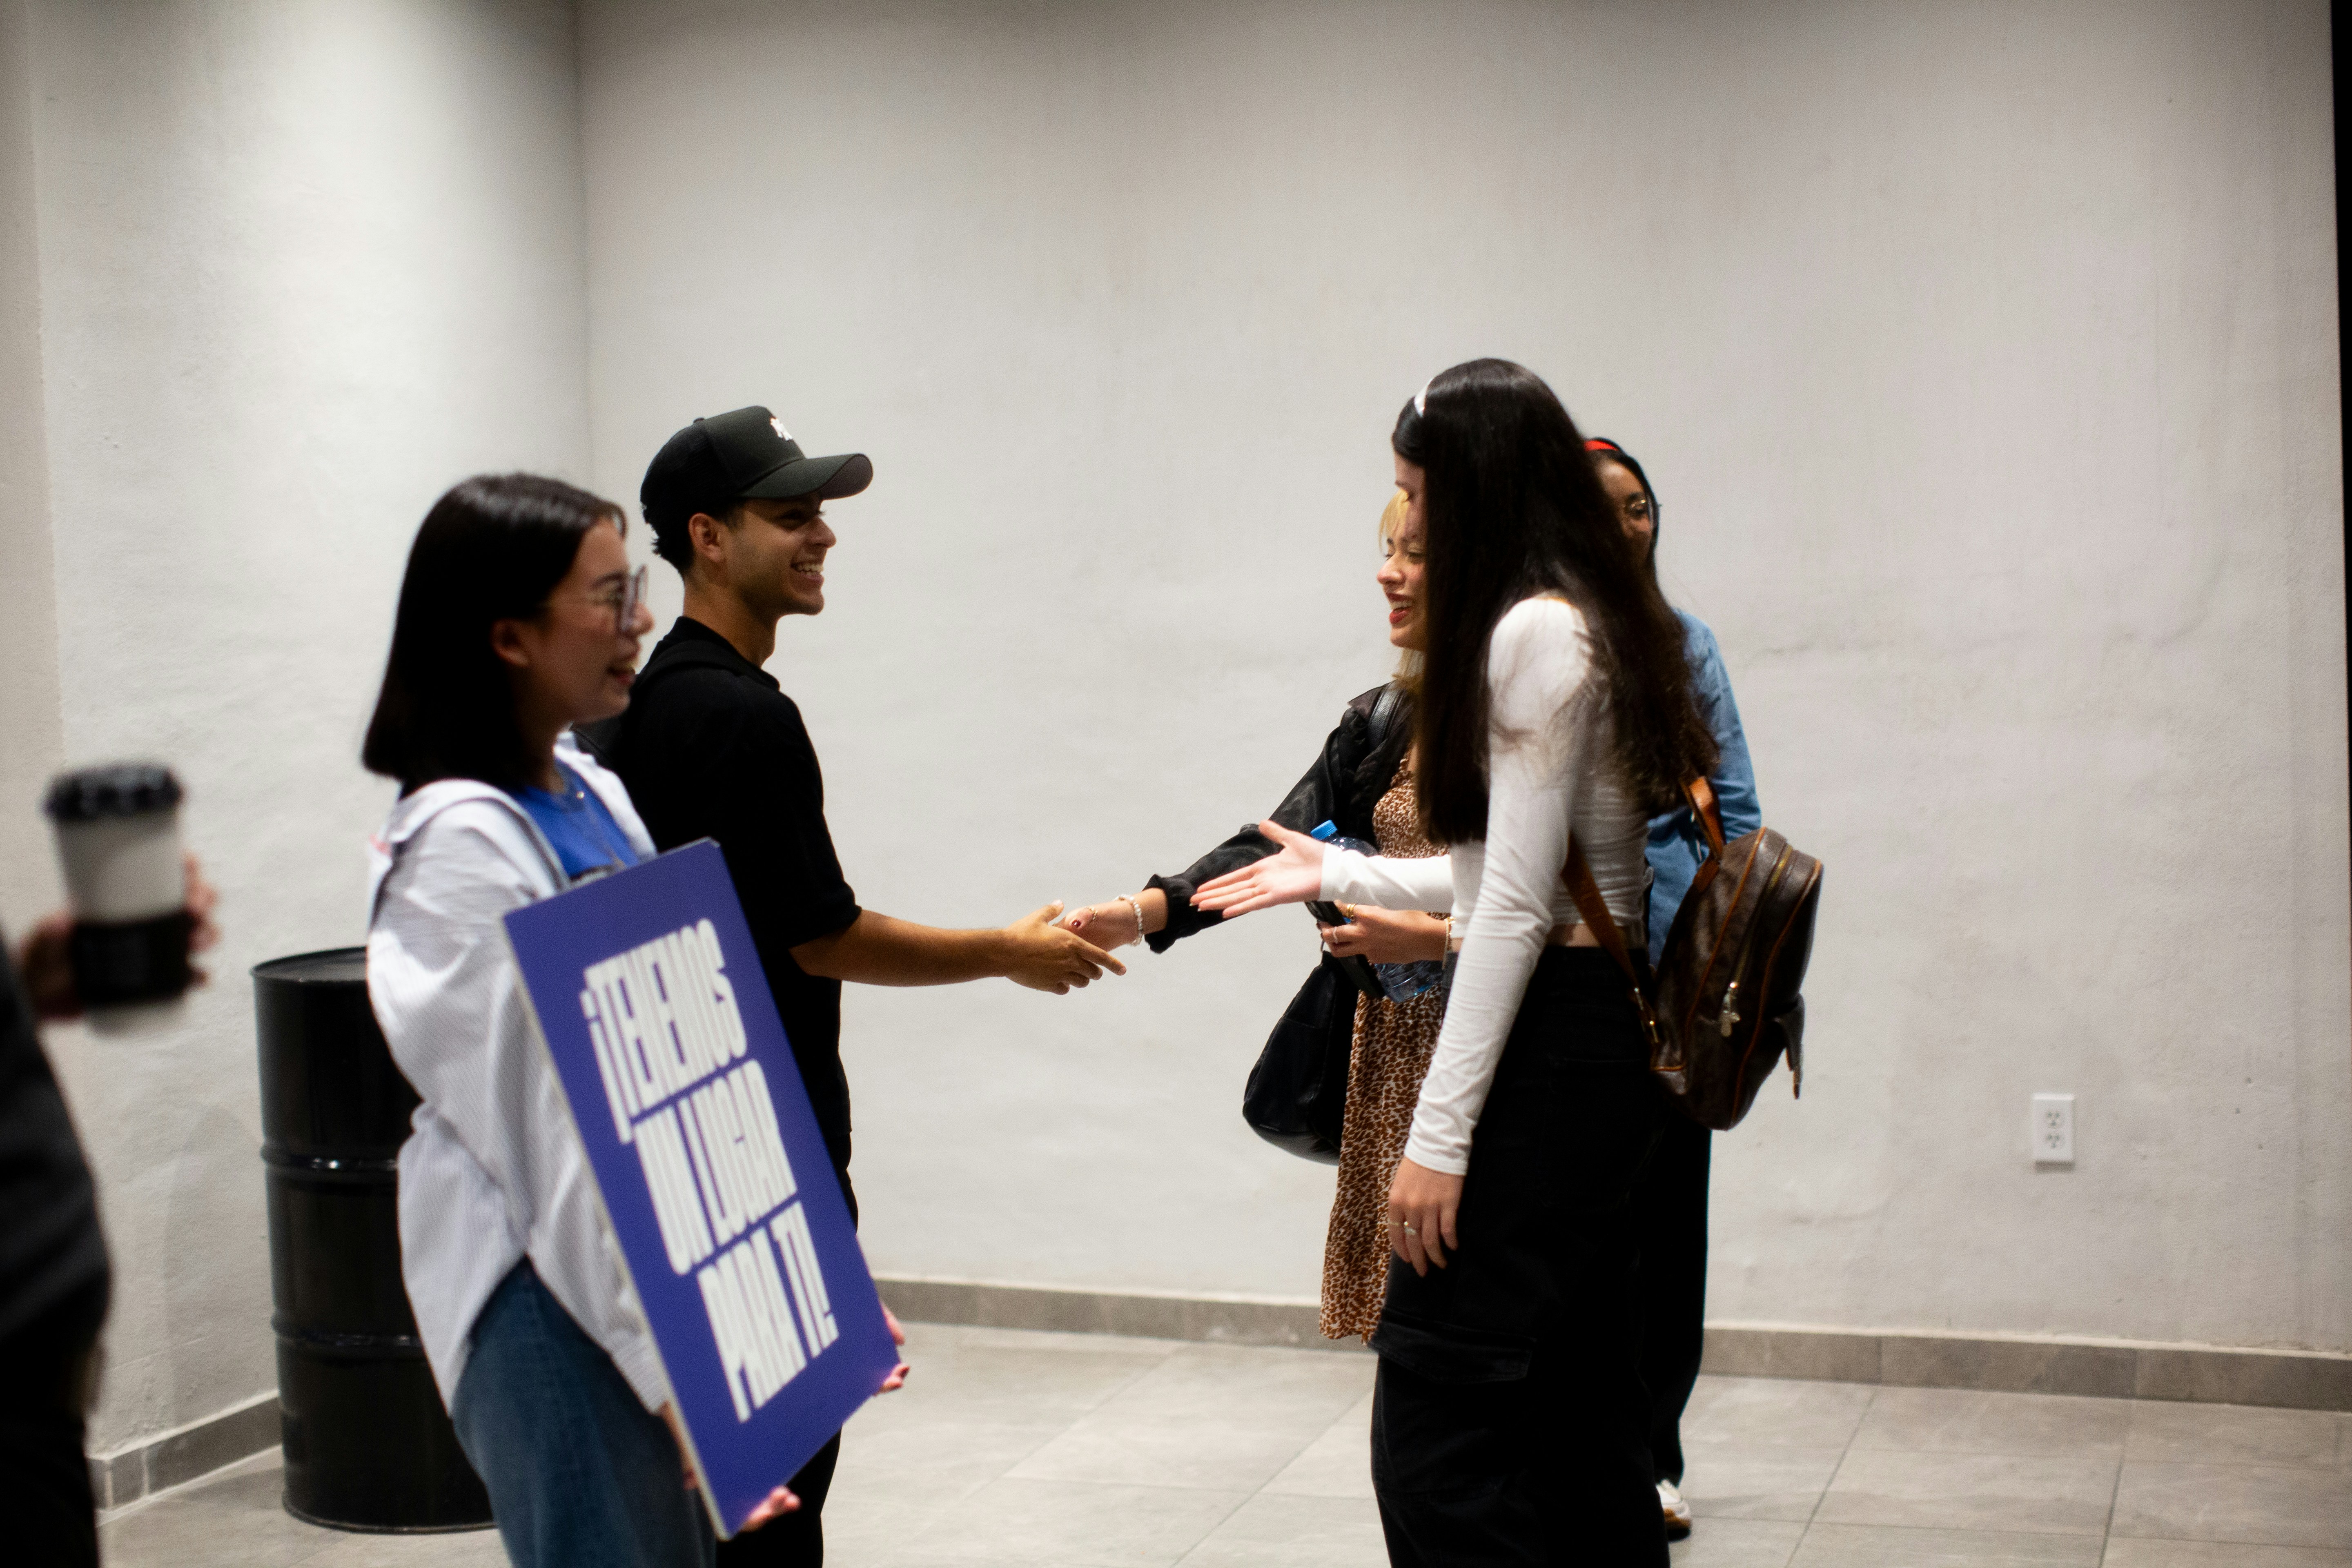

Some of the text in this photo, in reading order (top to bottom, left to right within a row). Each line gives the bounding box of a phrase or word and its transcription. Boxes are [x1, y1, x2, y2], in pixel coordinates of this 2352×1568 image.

[579, 918, 747, 1145] ¡TENEMOS
[633, 1059, 797, 1276] UN LUGAR
[697, 1201, 839, 1422] PARA TI!
